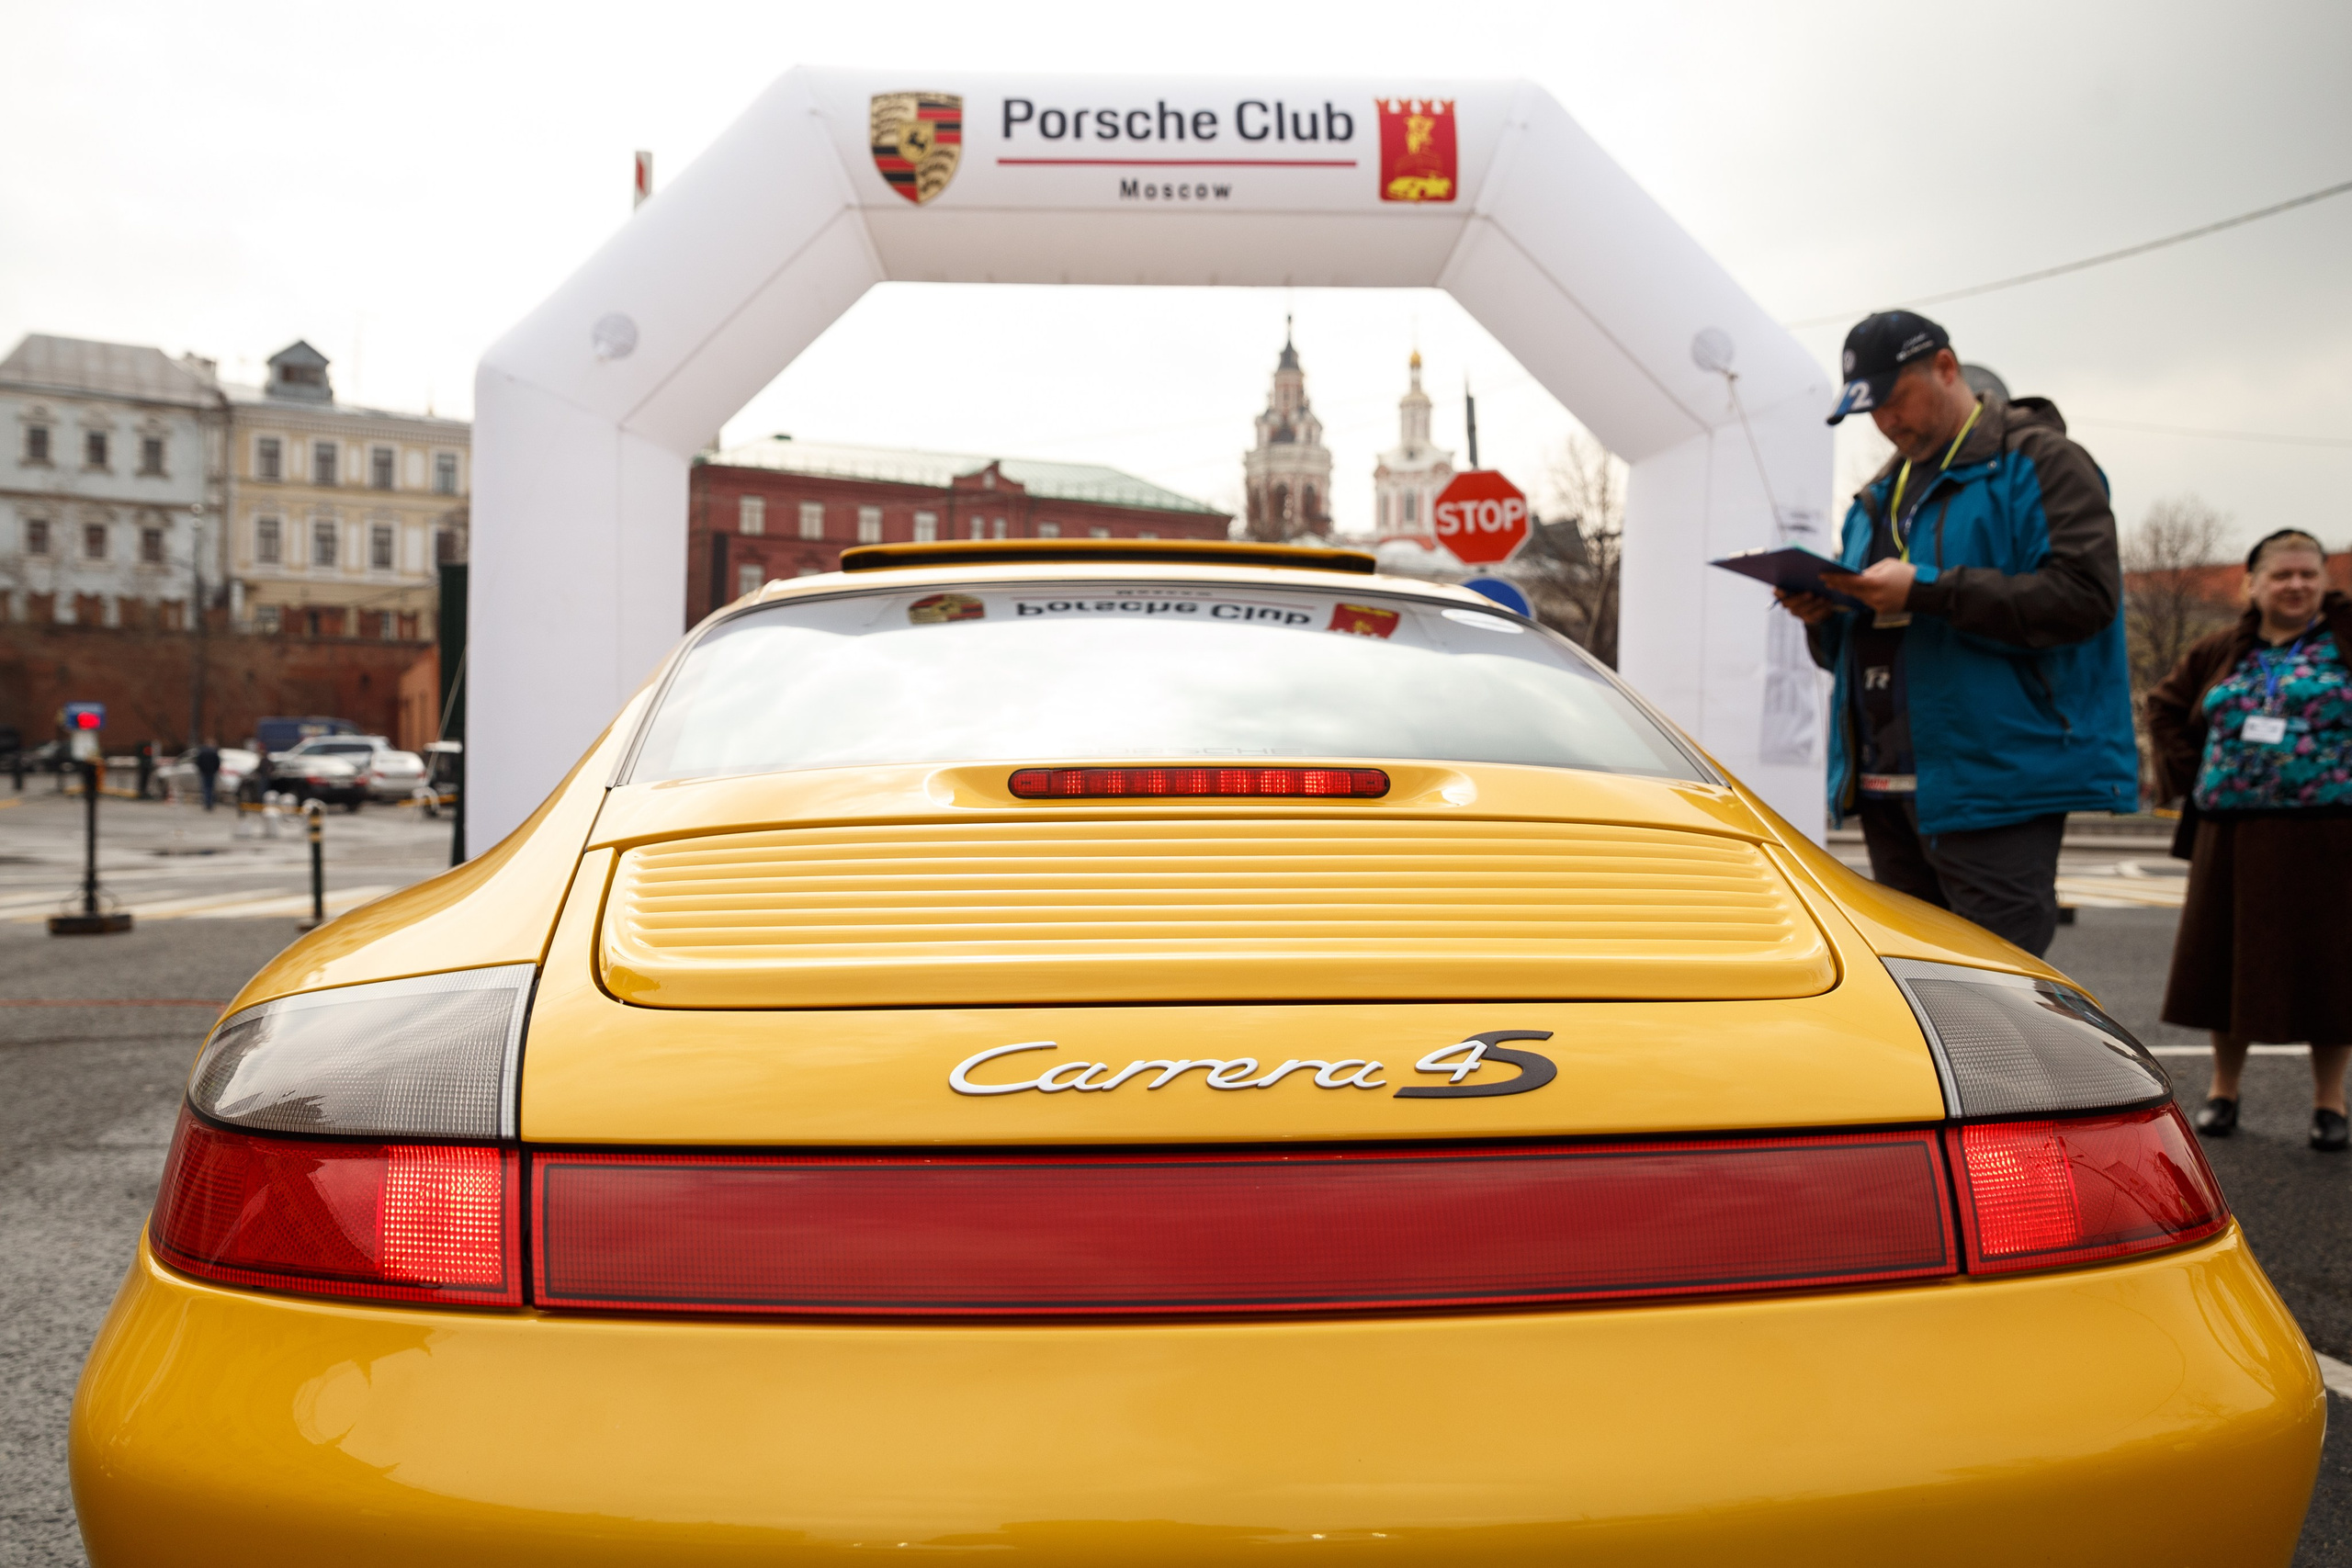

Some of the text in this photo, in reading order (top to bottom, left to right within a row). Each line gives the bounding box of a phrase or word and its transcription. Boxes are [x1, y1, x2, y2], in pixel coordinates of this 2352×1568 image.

[1001, 97, 1355, 143] Porsche Club
[1121, 179, 1232, 200] Moscow
[1436, 498, 1524, 536] STOP
[948, 1030, 1558, 1099] Carrera 4S
